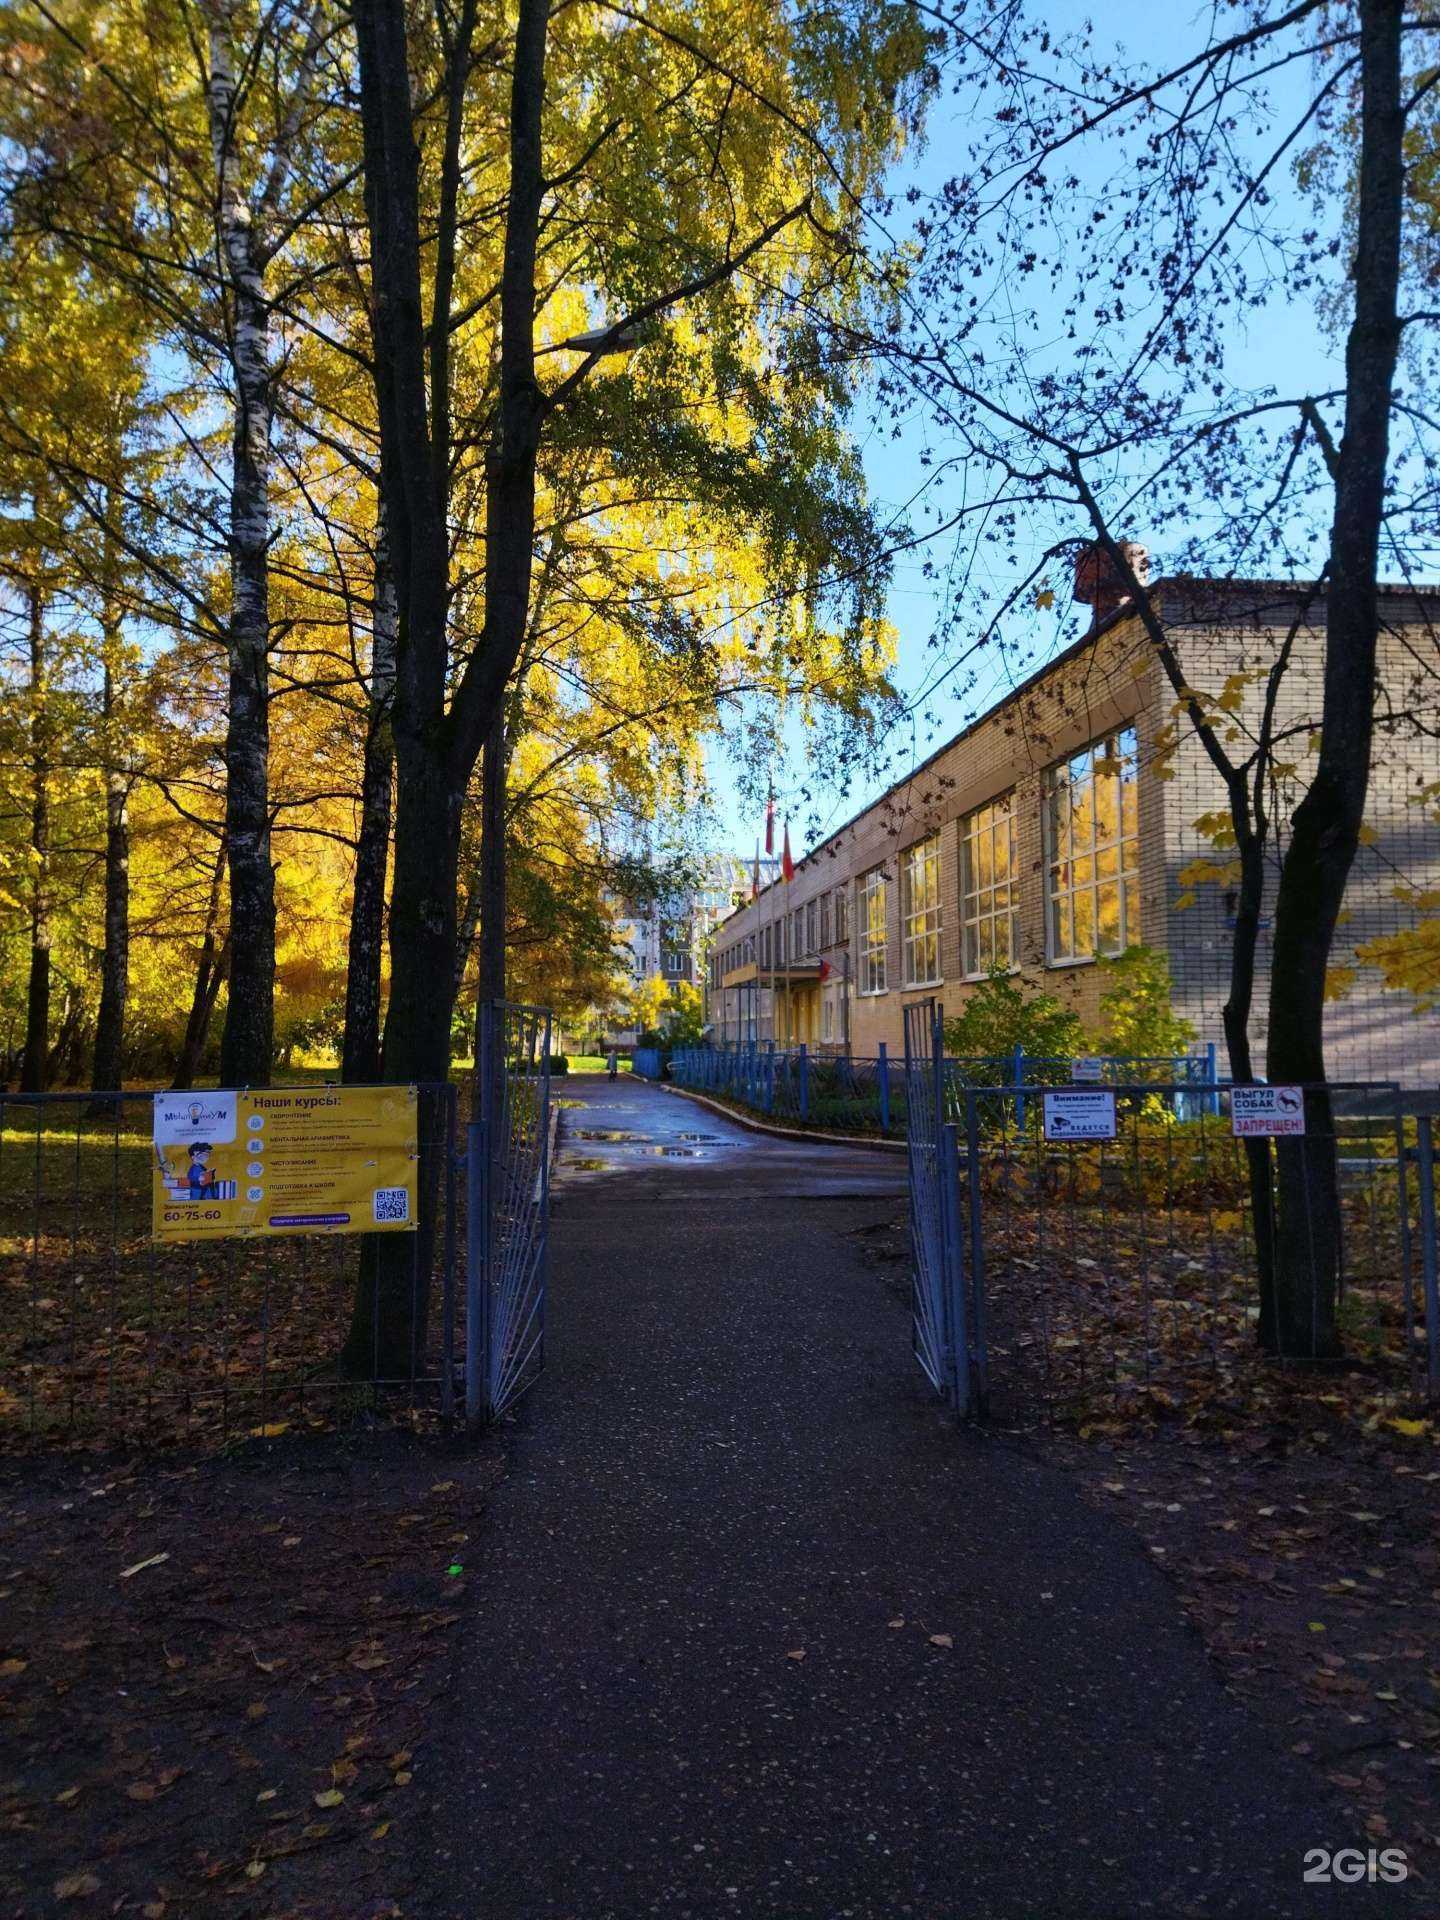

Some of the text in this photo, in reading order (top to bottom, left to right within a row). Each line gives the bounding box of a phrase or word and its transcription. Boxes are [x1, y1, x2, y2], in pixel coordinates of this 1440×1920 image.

[1053, 1094, 1105, 1102] Внимание!
[1234, 1090, 1274, 1099] ВЫГУЛ
[254, 1097, 341, 1109] Наши курсы:
[1234, 1099, 1273, 1108] СОБАК
[1235, 1120, 1302, 1133] ЗАПРЕЩЕН!
[164, 1210, 221, 1222] 60-75-60
